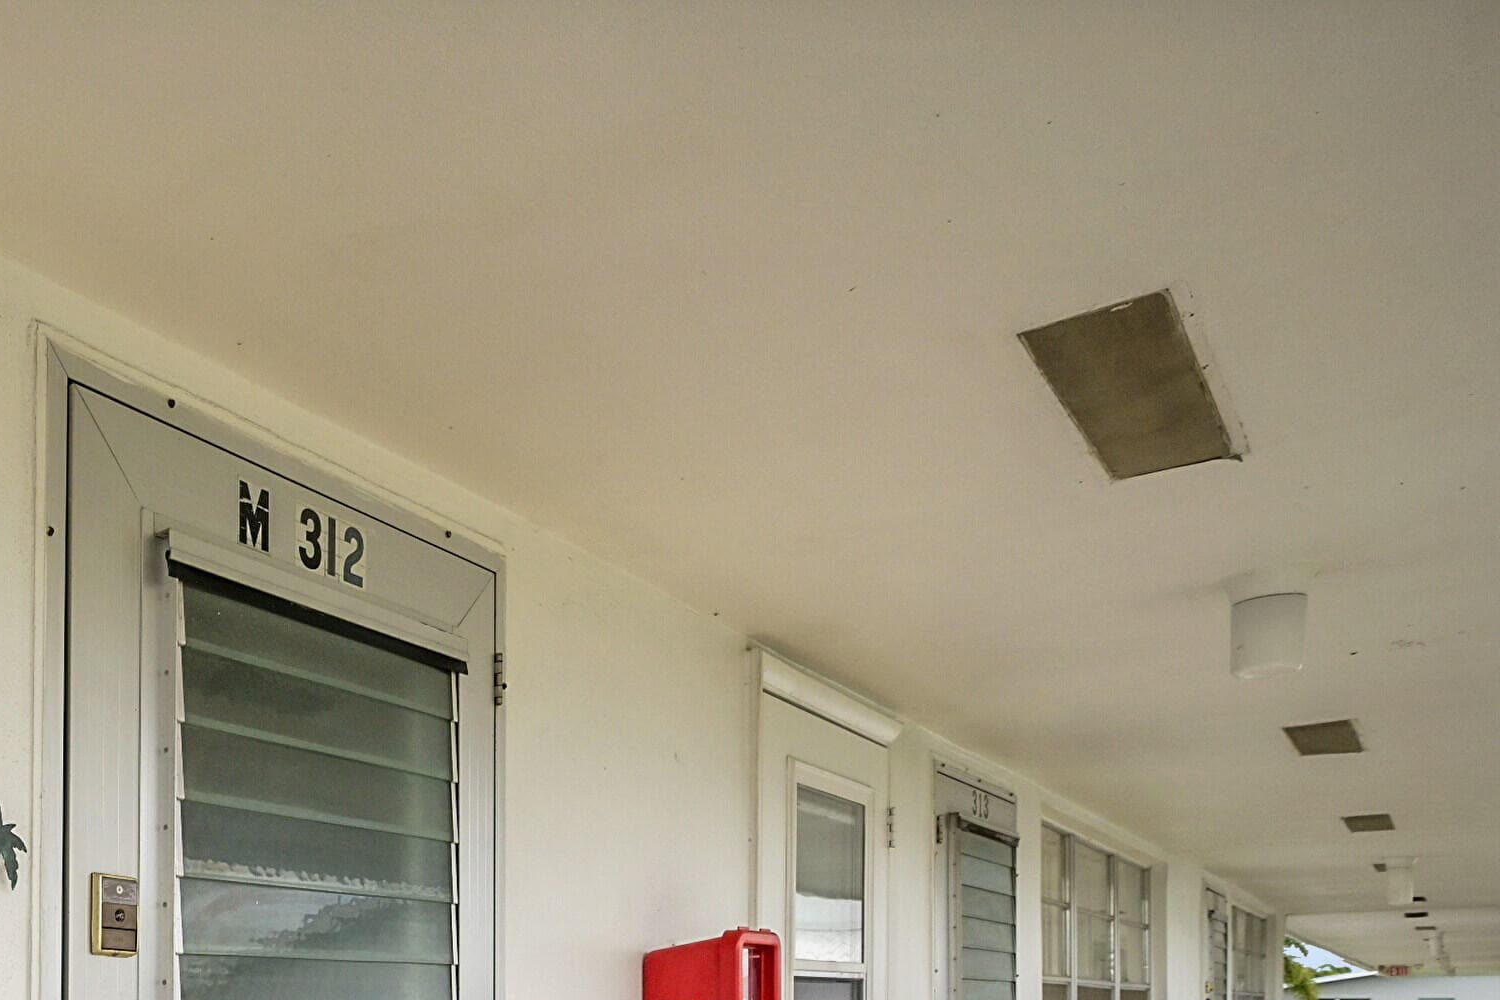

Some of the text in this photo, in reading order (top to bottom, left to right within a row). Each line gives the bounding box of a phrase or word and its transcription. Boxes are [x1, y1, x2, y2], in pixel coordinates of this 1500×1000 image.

[238, 479, 365, 588] M 312
[971, 789, 989, 819] 313
